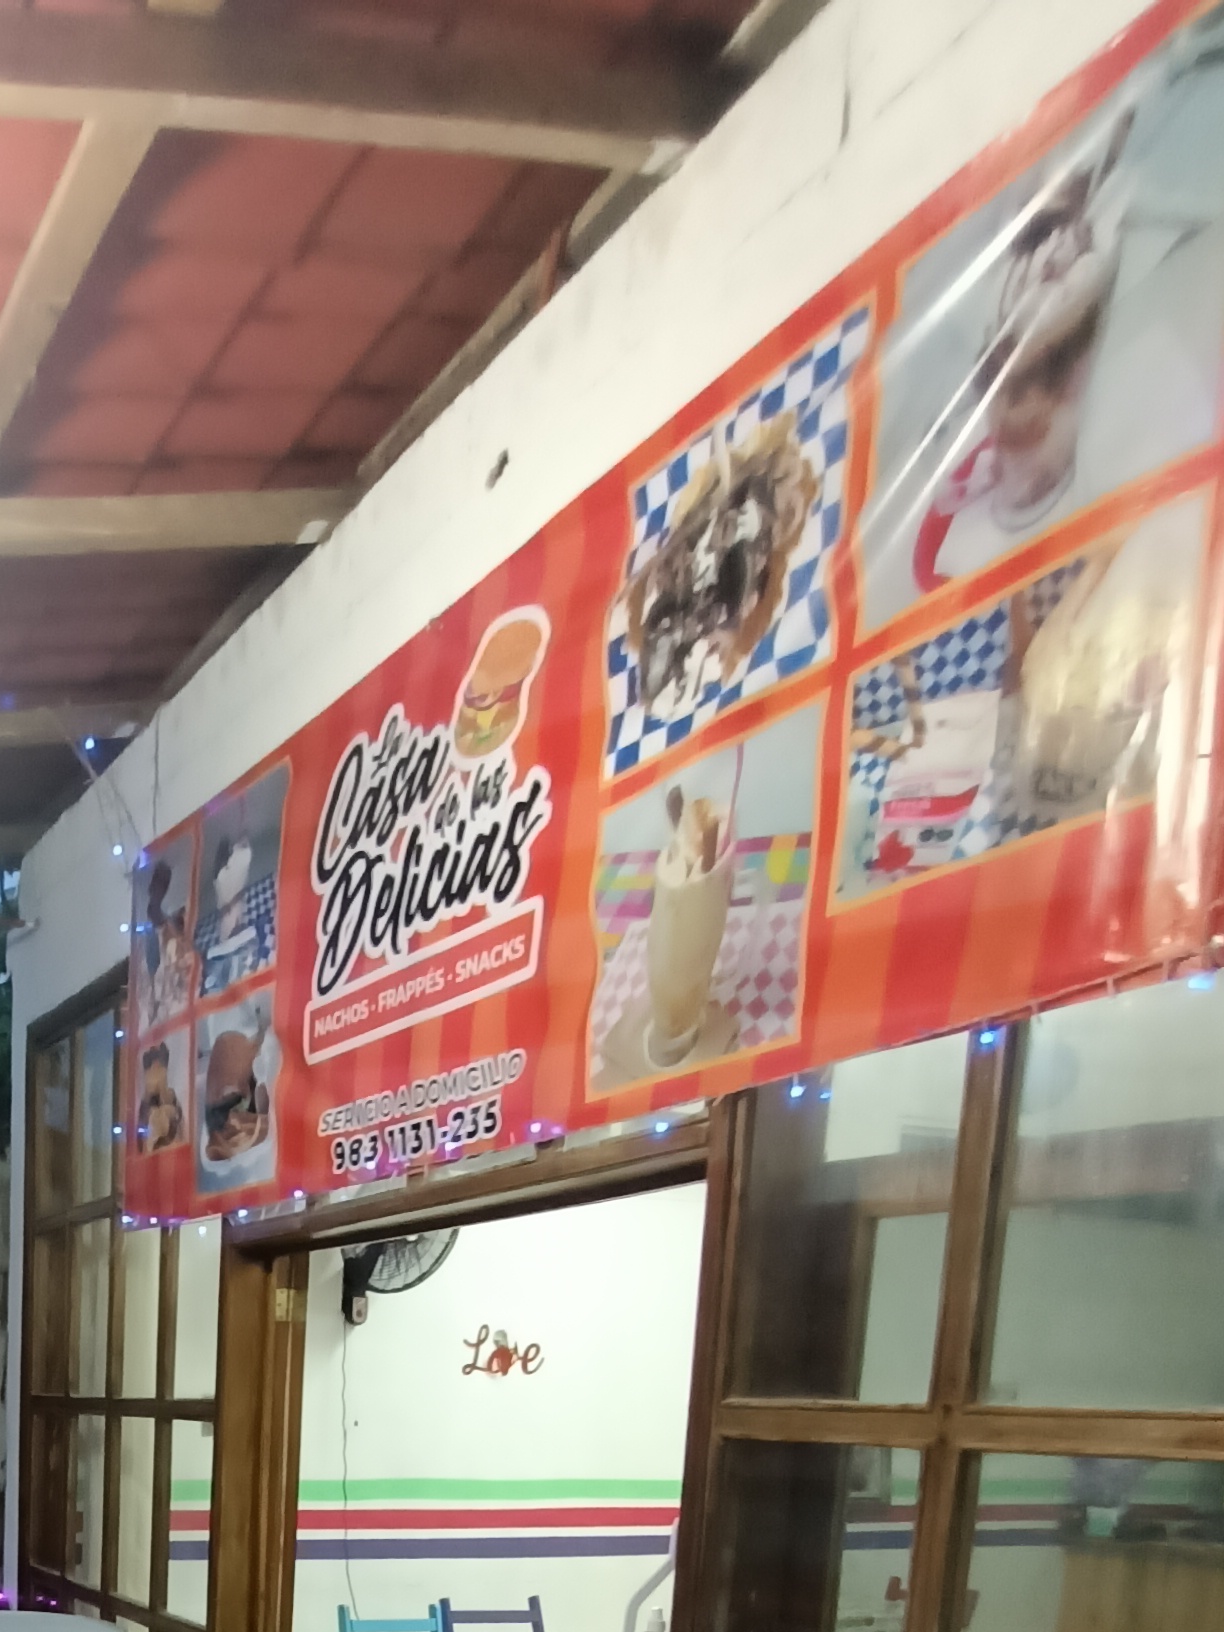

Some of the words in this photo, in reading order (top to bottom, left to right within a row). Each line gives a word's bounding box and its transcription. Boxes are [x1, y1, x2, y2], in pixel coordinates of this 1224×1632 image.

[317, 734, 451, 884] Casa
[434, 783, 460, 838] de
[470, 758, 509, 821] las
[317, 779, 543, 996] Delicias
[314, 999, 370, 1038] NACHOS
[377, 966, 445, 1013] FRAPPÉS
[455, 935, 526, 983] SNACKS
[411, 1052, 523, 1110] DOMICILIO
[333, 1134, 379, 1171] 983
